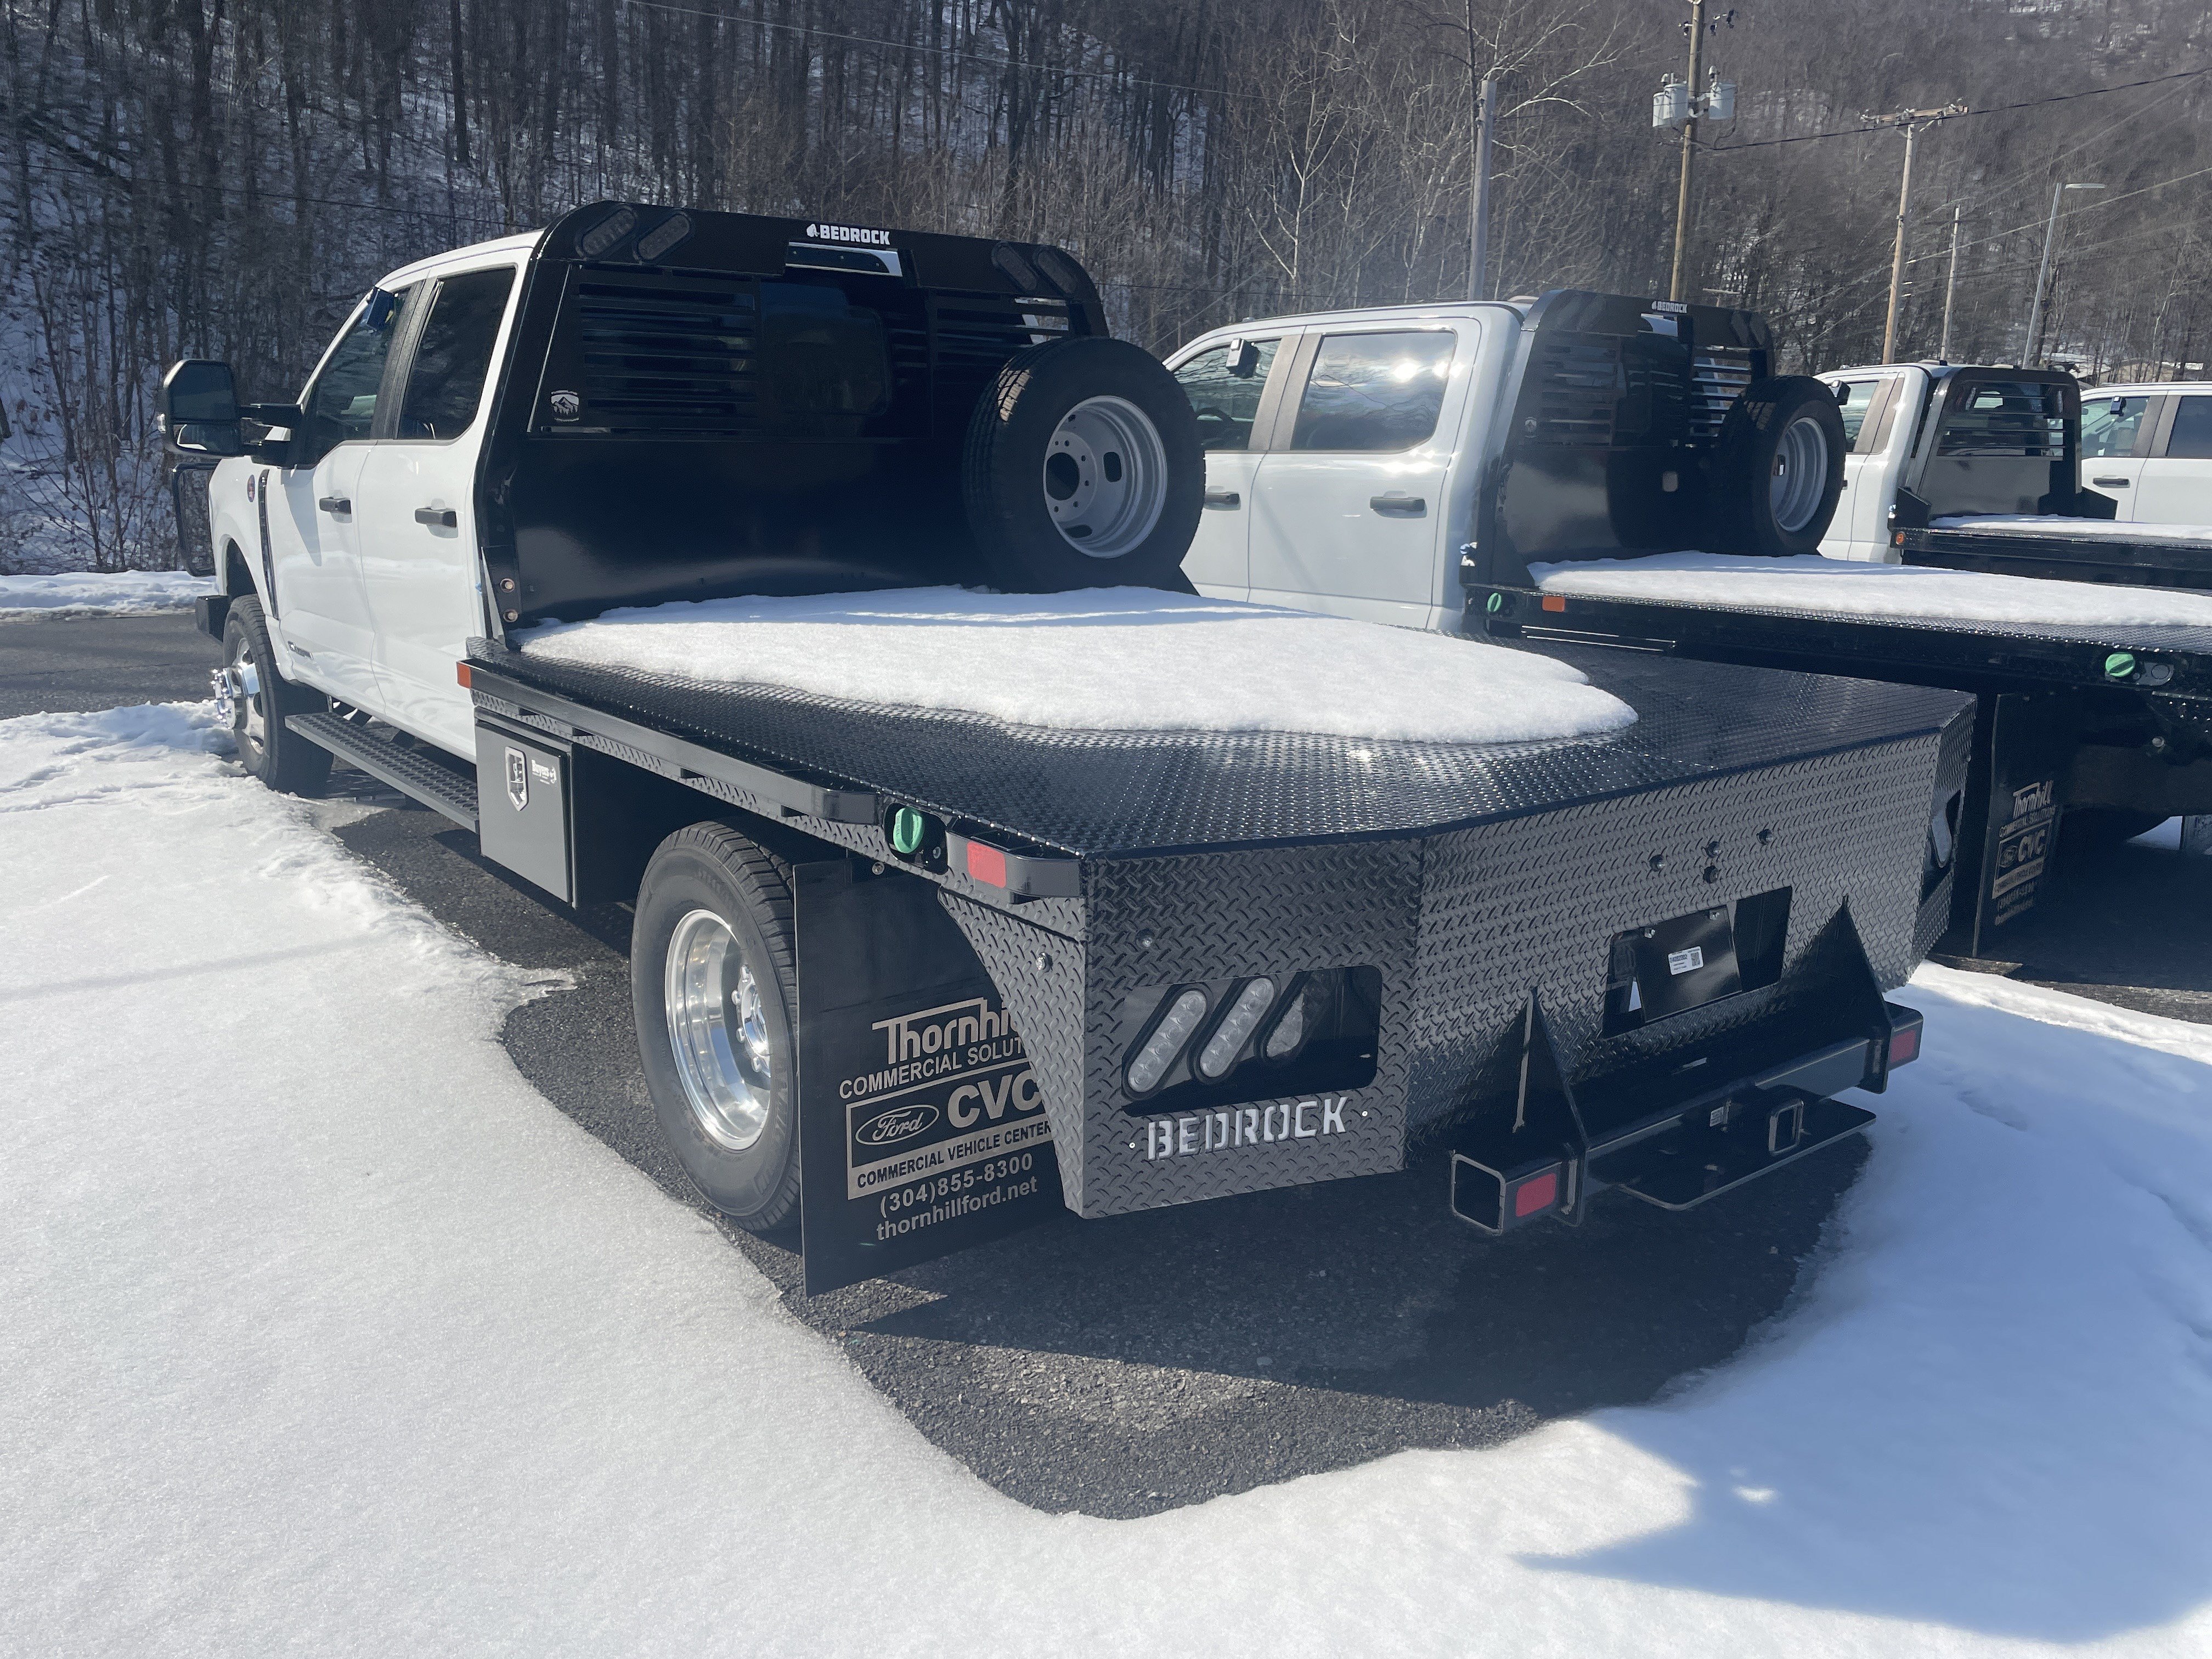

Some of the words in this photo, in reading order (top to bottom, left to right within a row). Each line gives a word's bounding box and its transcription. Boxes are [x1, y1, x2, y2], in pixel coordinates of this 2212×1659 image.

[820, 224, 890, 245] BEDROCK
[1657, 301, 1688, 313] BEDROCK
[872, 997, 1018, 1065] Thornhi
[839, 1051, 962, 1099] COMMERCIAL
[967, 1036, 1023, 1065] SOLUT
[947, 1069, 1042, 1128] CVC
[857, 1150, 945, 1189] COMMERCIAL
[947, 1133, 1001, 1161] VEHICLE
[1004, 1120, 1052, 1145] CENTER
[872, 1110, 924, 1141] Ford
[1147, 1097, 1348, 1162] BEDROCK
[876, 1175, 1038, 1241] thornhillford.net
[880, 1153, 1033, 1218] (304)855-8300
